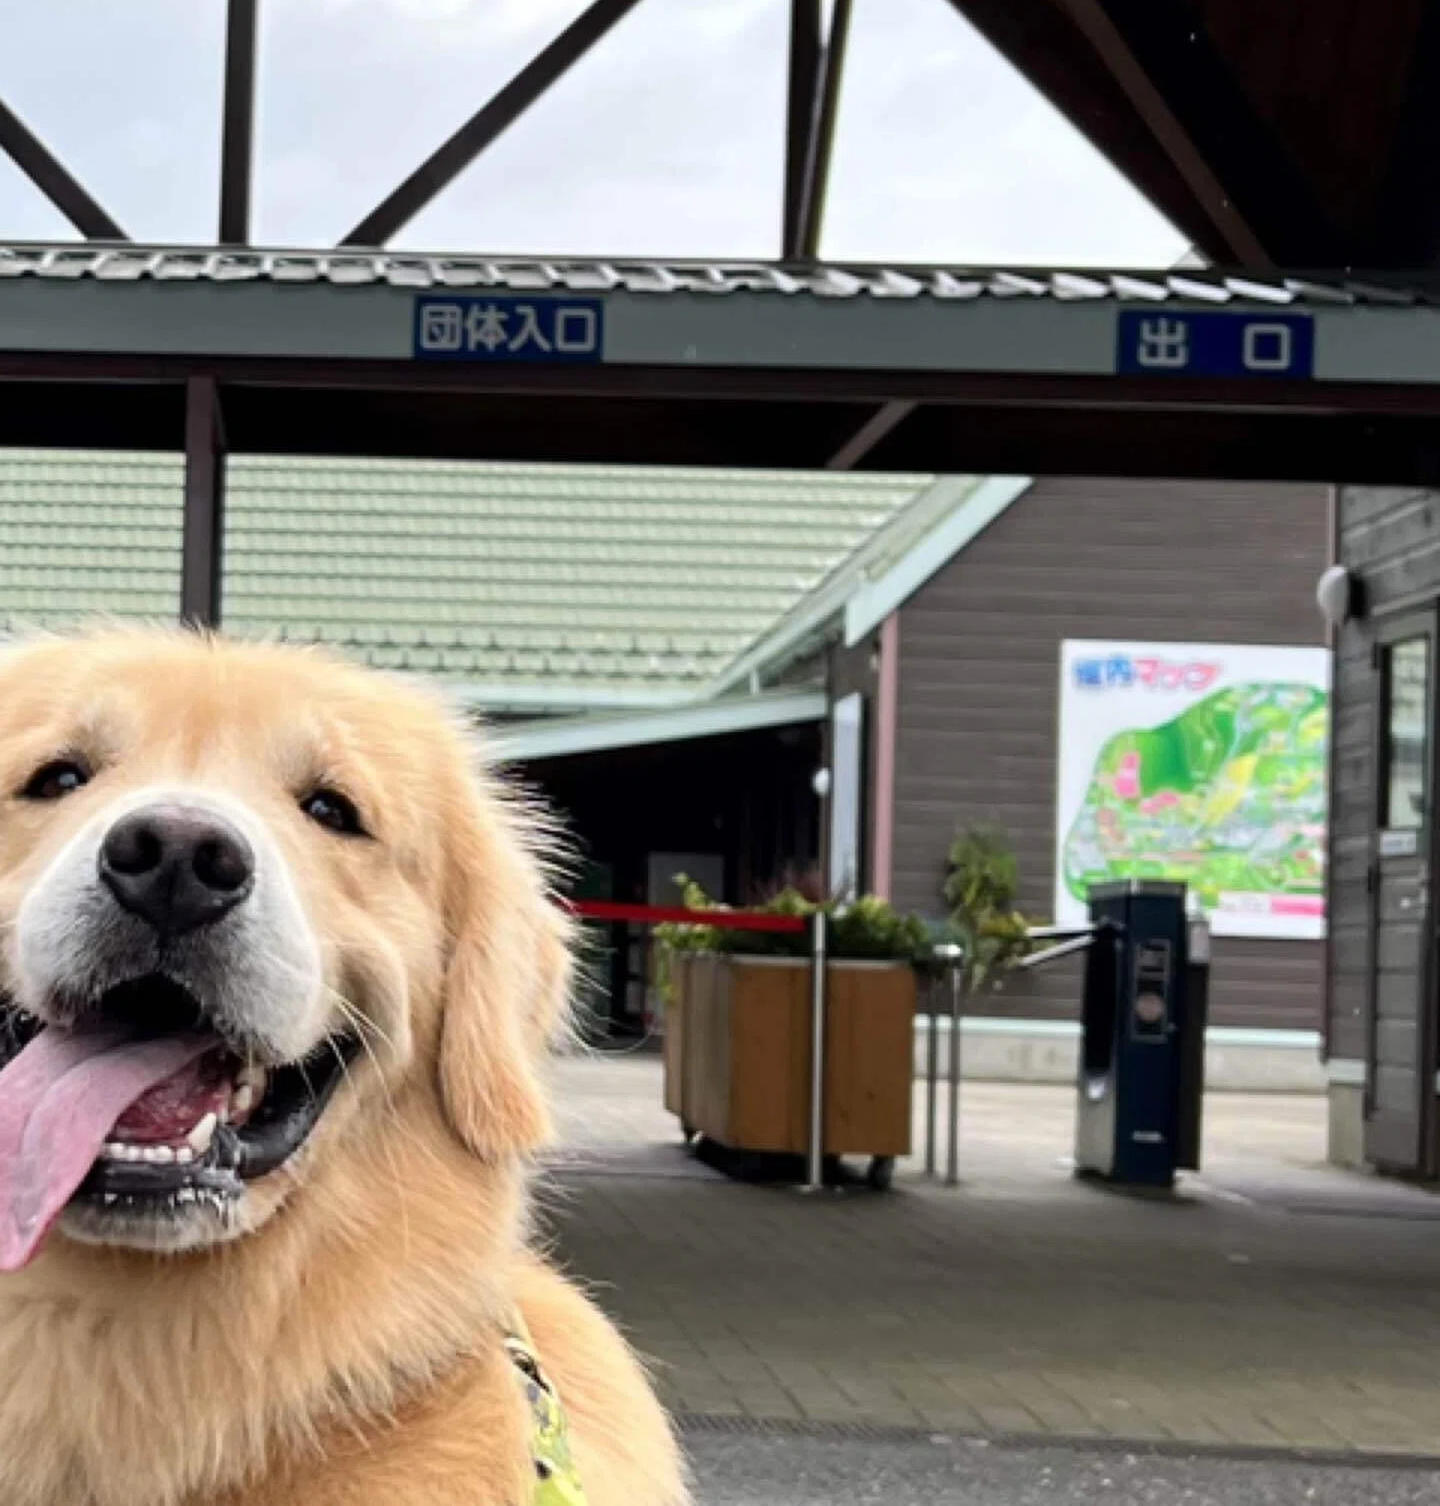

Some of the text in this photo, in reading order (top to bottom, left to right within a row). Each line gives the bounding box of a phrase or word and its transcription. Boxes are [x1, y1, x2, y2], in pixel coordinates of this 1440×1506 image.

[420, 304, 597, 352] 団体入口
[1137, 319, 1290, 370] 出口
